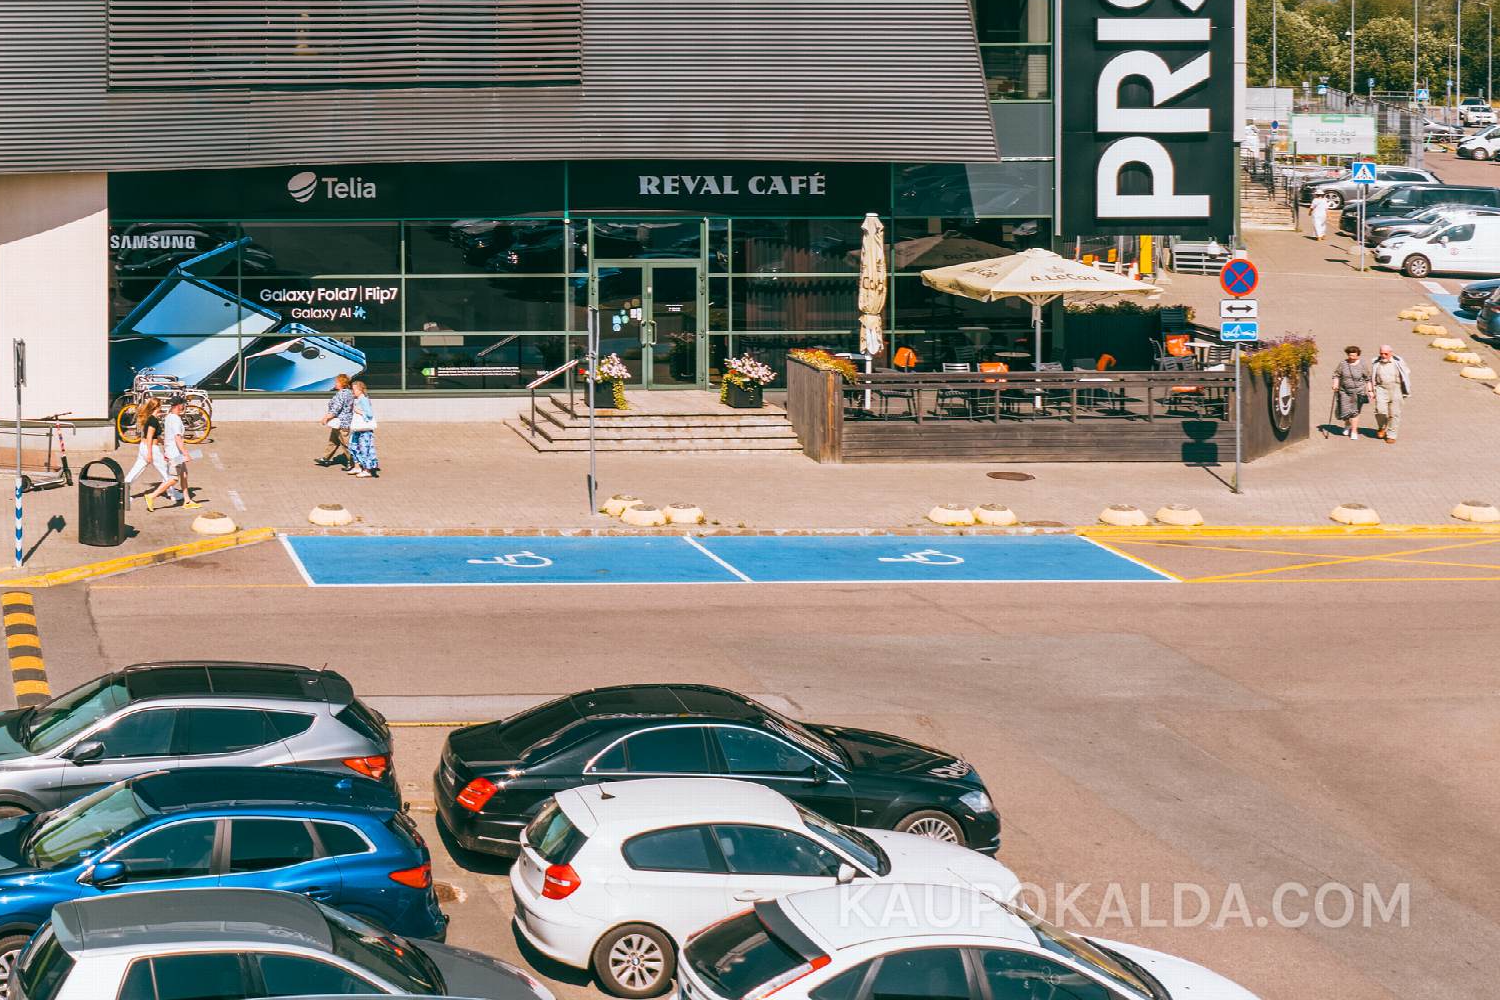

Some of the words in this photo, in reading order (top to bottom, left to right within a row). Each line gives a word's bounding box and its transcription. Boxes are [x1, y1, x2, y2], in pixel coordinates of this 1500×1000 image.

[322, 177, 376, 199] Telia
[638, 175, 740, 195] REVAL
[747, 171, 827, 195] CAFÉ
[110, 235, 196, 249] SAMSUNG
[260, 289, 314, 304] Galaxy
[317, 287, 358, 301] Fold7
[364, 287, 399, 303] Flip7
[291, 306, 337, 321] Galaxy
[339, 307, 352, 318] AI
